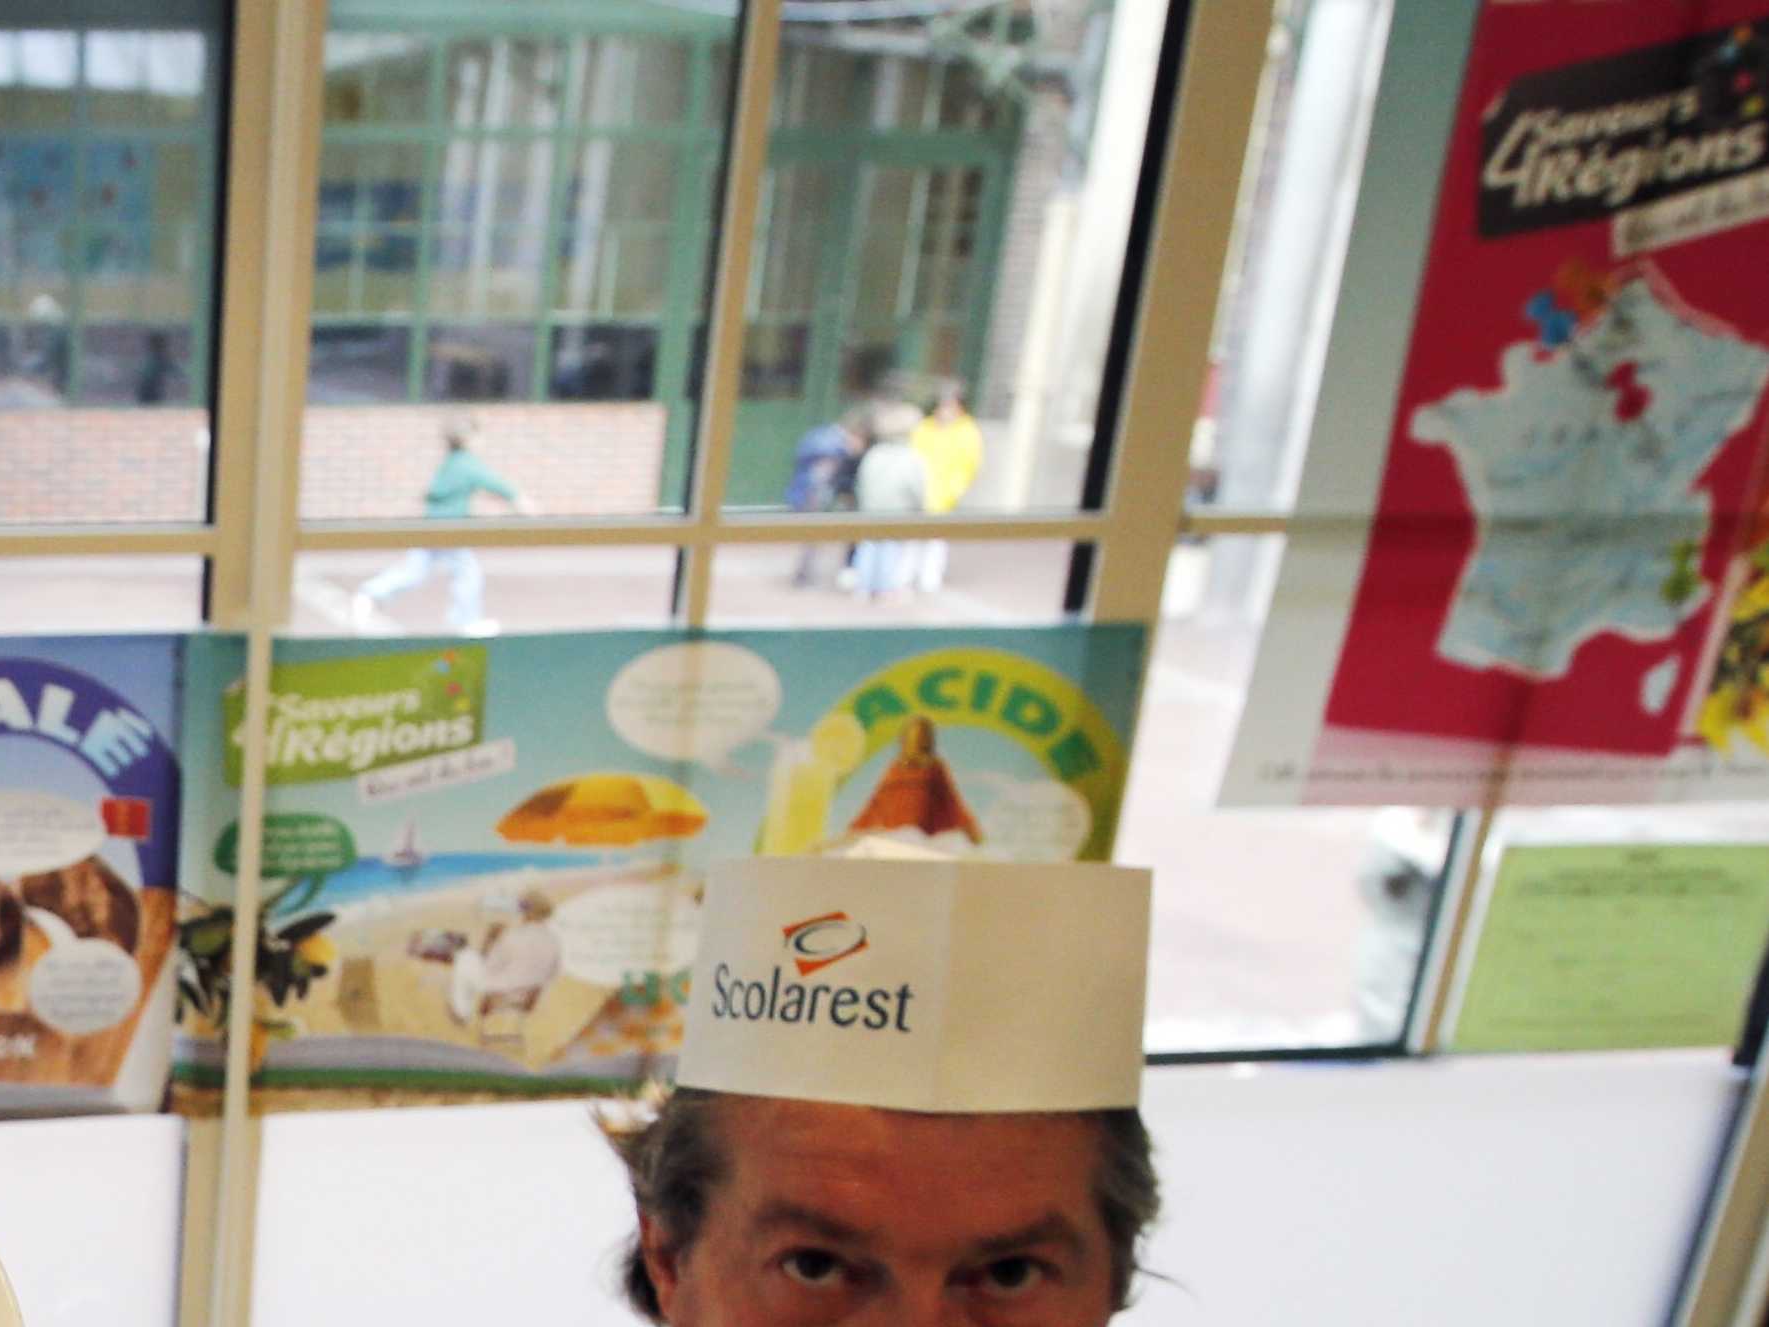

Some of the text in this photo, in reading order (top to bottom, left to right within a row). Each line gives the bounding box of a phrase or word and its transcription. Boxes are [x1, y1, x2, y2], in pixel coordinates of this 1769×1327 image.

[273, 688, 421, 722] Saveurs
[852, 665, 1103, 783] ACIDE
[282, 713, 476, 771] Régions
[712, 961, 914, 1033] Scolarest
